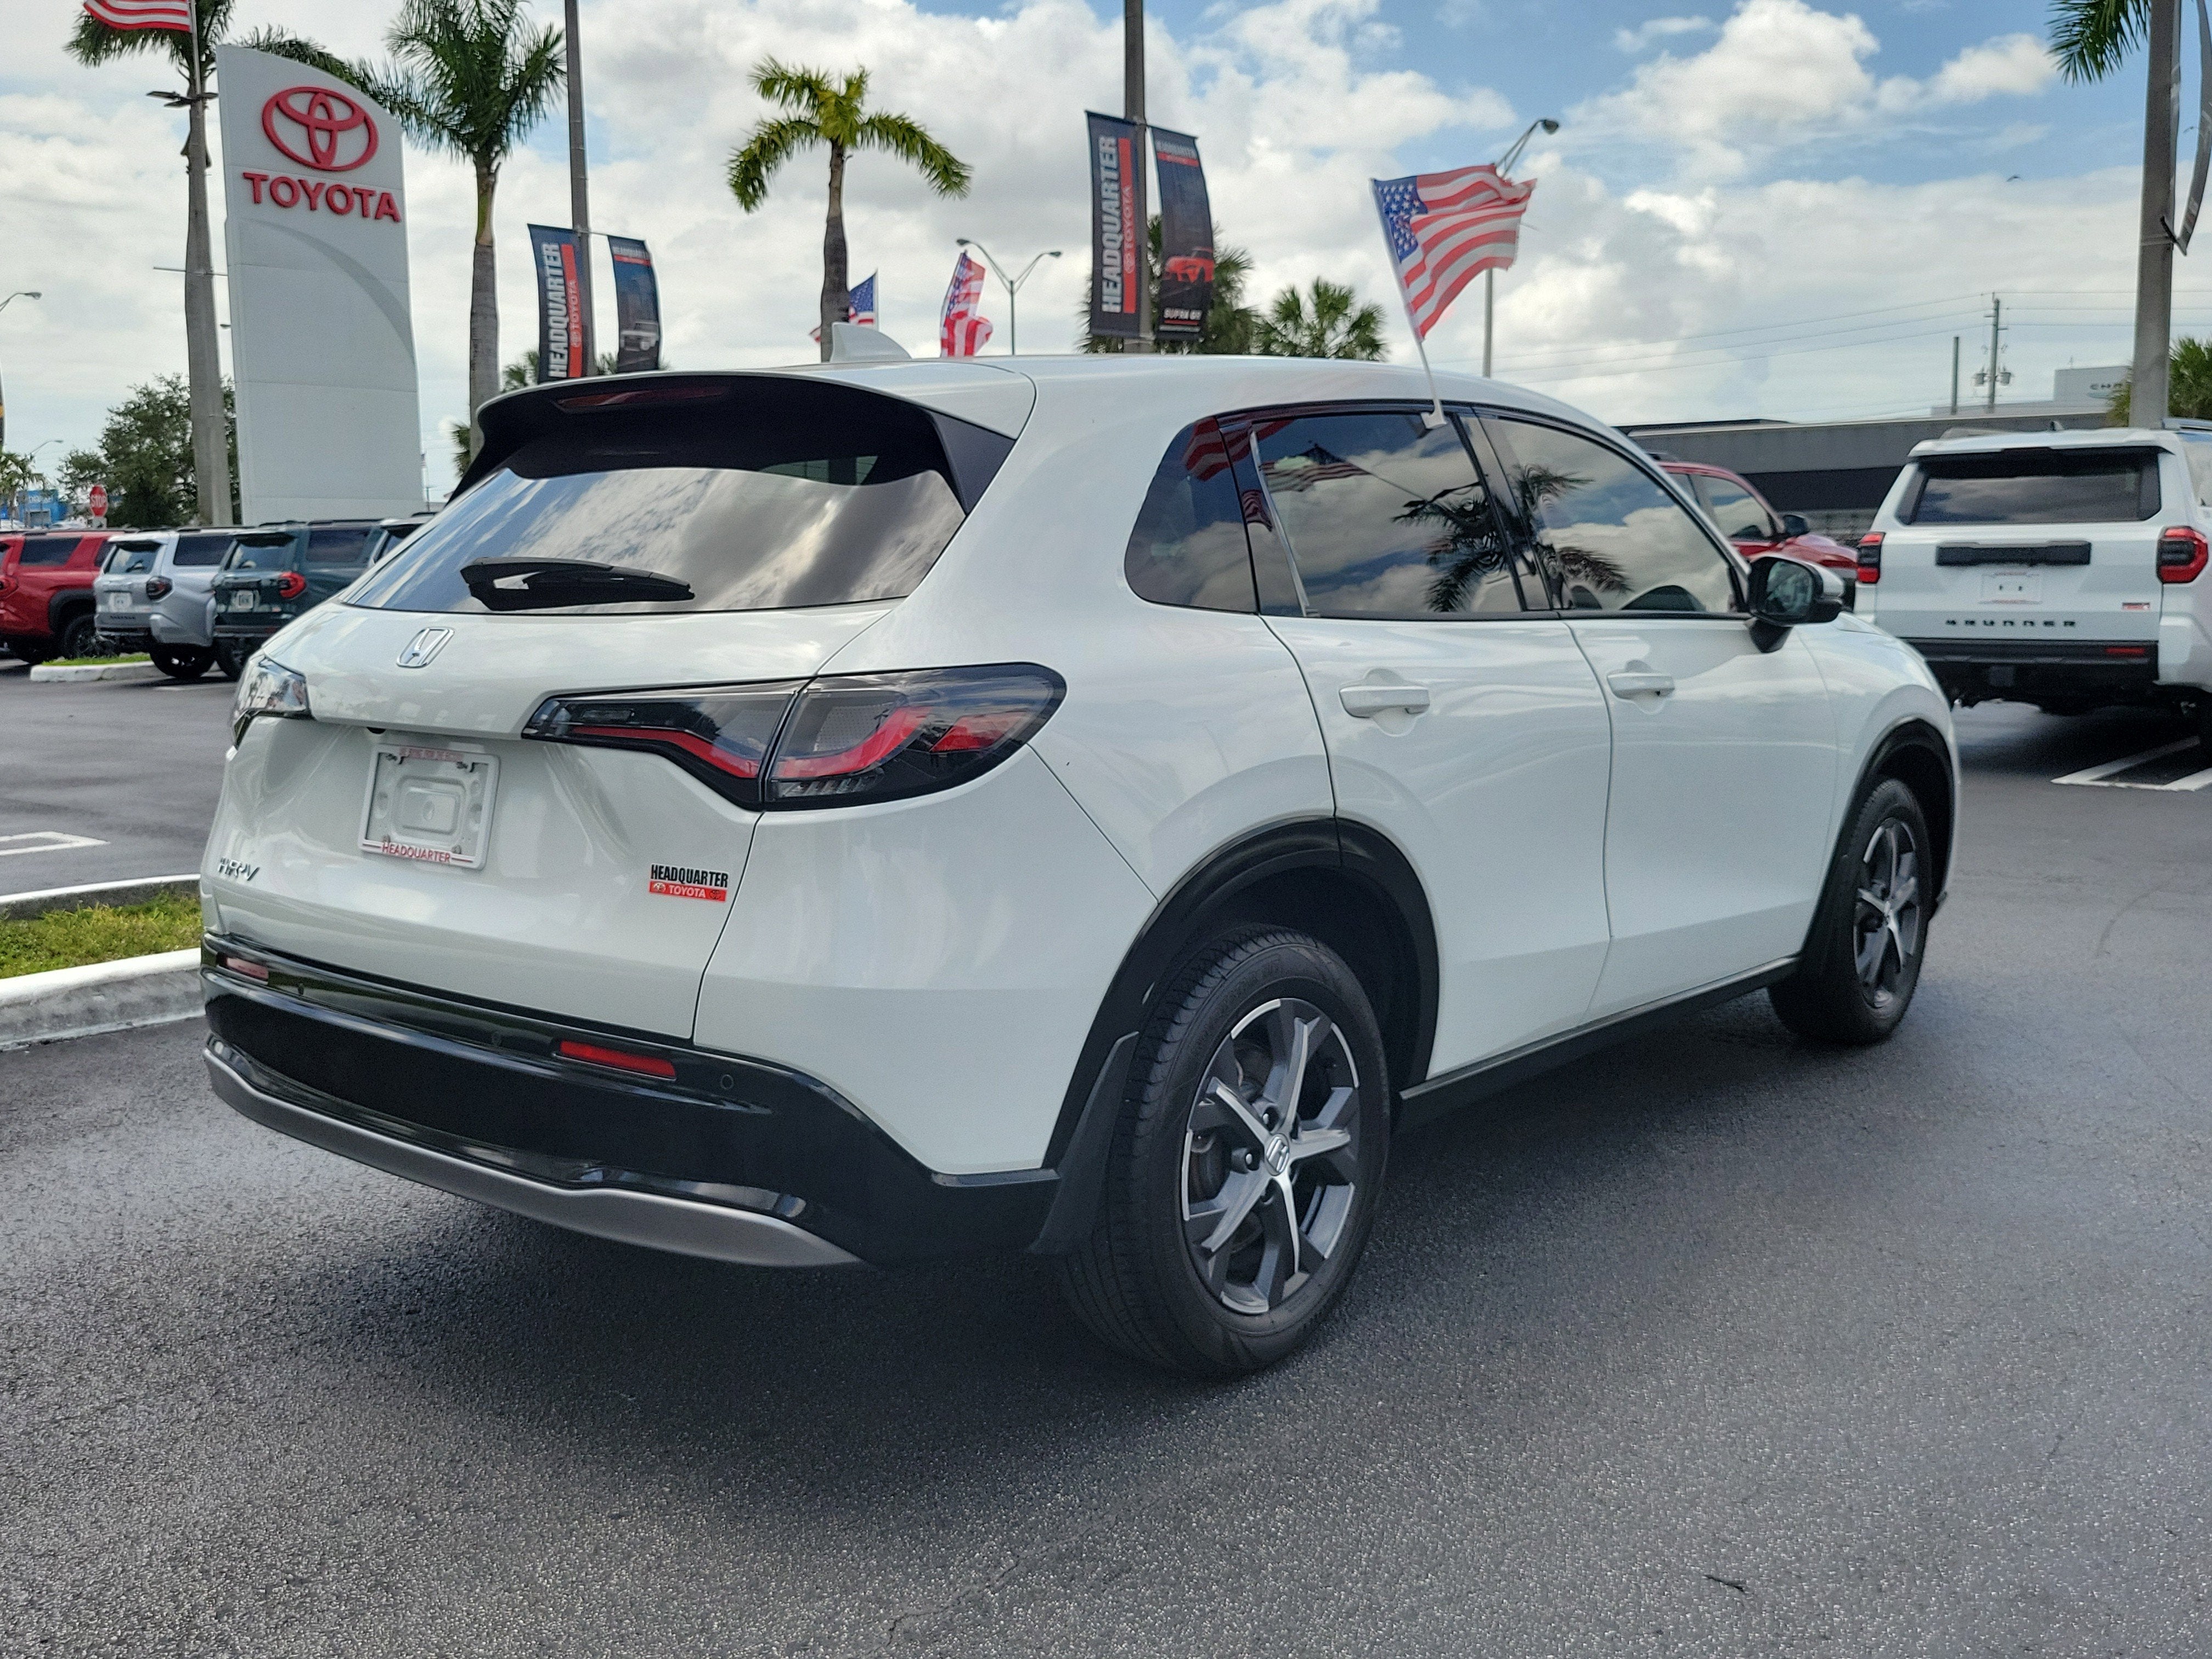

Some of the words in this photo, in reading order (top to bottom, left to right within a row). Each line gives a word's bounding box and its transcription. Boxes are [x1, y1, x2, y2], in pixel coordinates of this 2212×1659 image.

[243, 172, 401, 223] TOYOTA
[1123, 185, 1135, 251] TOYOTA
[1098, 137, 1124, 312] HEADQUARTER
[542, 243, 569, 377] HEADQUARTER
[567, 280, 580, 330] TOYOTA
[91, 495, 107, 507] STOP
[382, 842, 450, 862] HEADQUARTER
[651, 864, 729, 888] HEADQUARTER
[669, 884, 706, 898] TOYOTA
